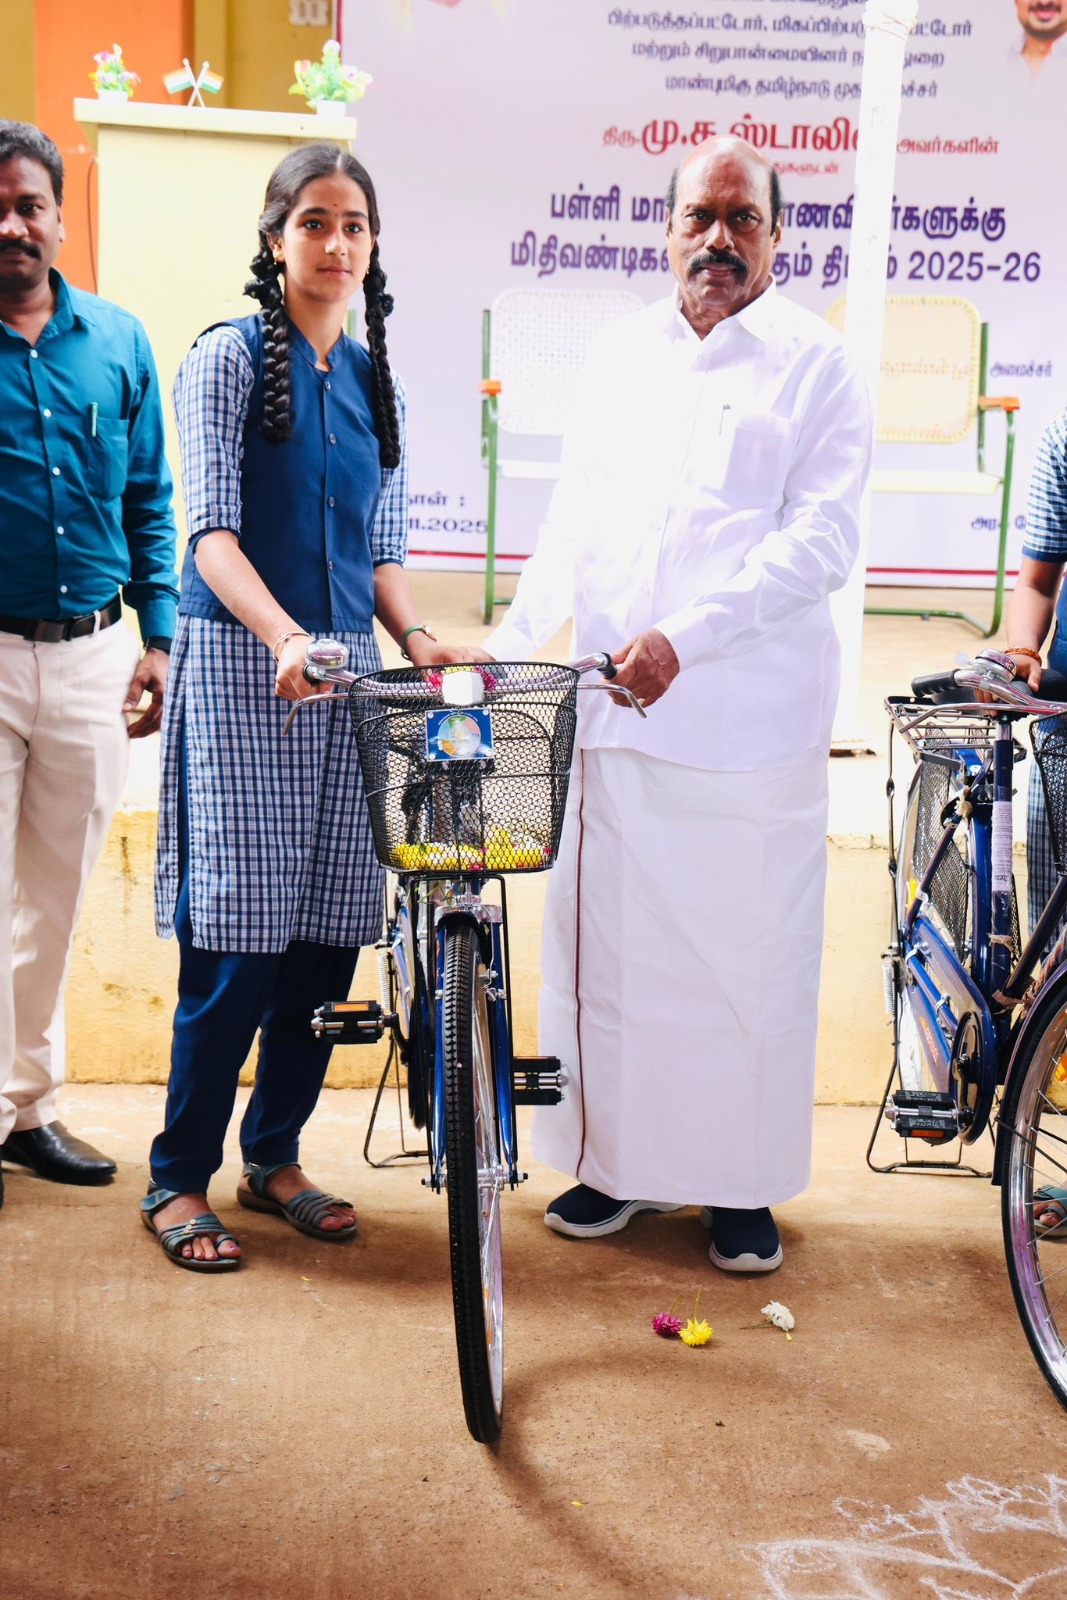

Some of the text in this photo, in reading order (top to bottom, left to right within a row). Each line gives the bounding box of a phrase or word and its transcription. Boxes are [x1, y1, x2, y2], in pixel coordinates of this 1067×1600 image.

[633, 41, 690, 61] மற்றும்
[695, 42, 848, 64] சிறுபான்மையினர்
[665, 74, 751, 95] மாண்புமிகு
[755, 75, 830, 99] தமிழ்நாடு
[730, 113, 859, 151] ஸ்டாலி
[896, 135, 999, 155] அவர்களின்
[551, 183, 620, 221] பள்ளி
[908, 250, 1041, 282] 2025-26
